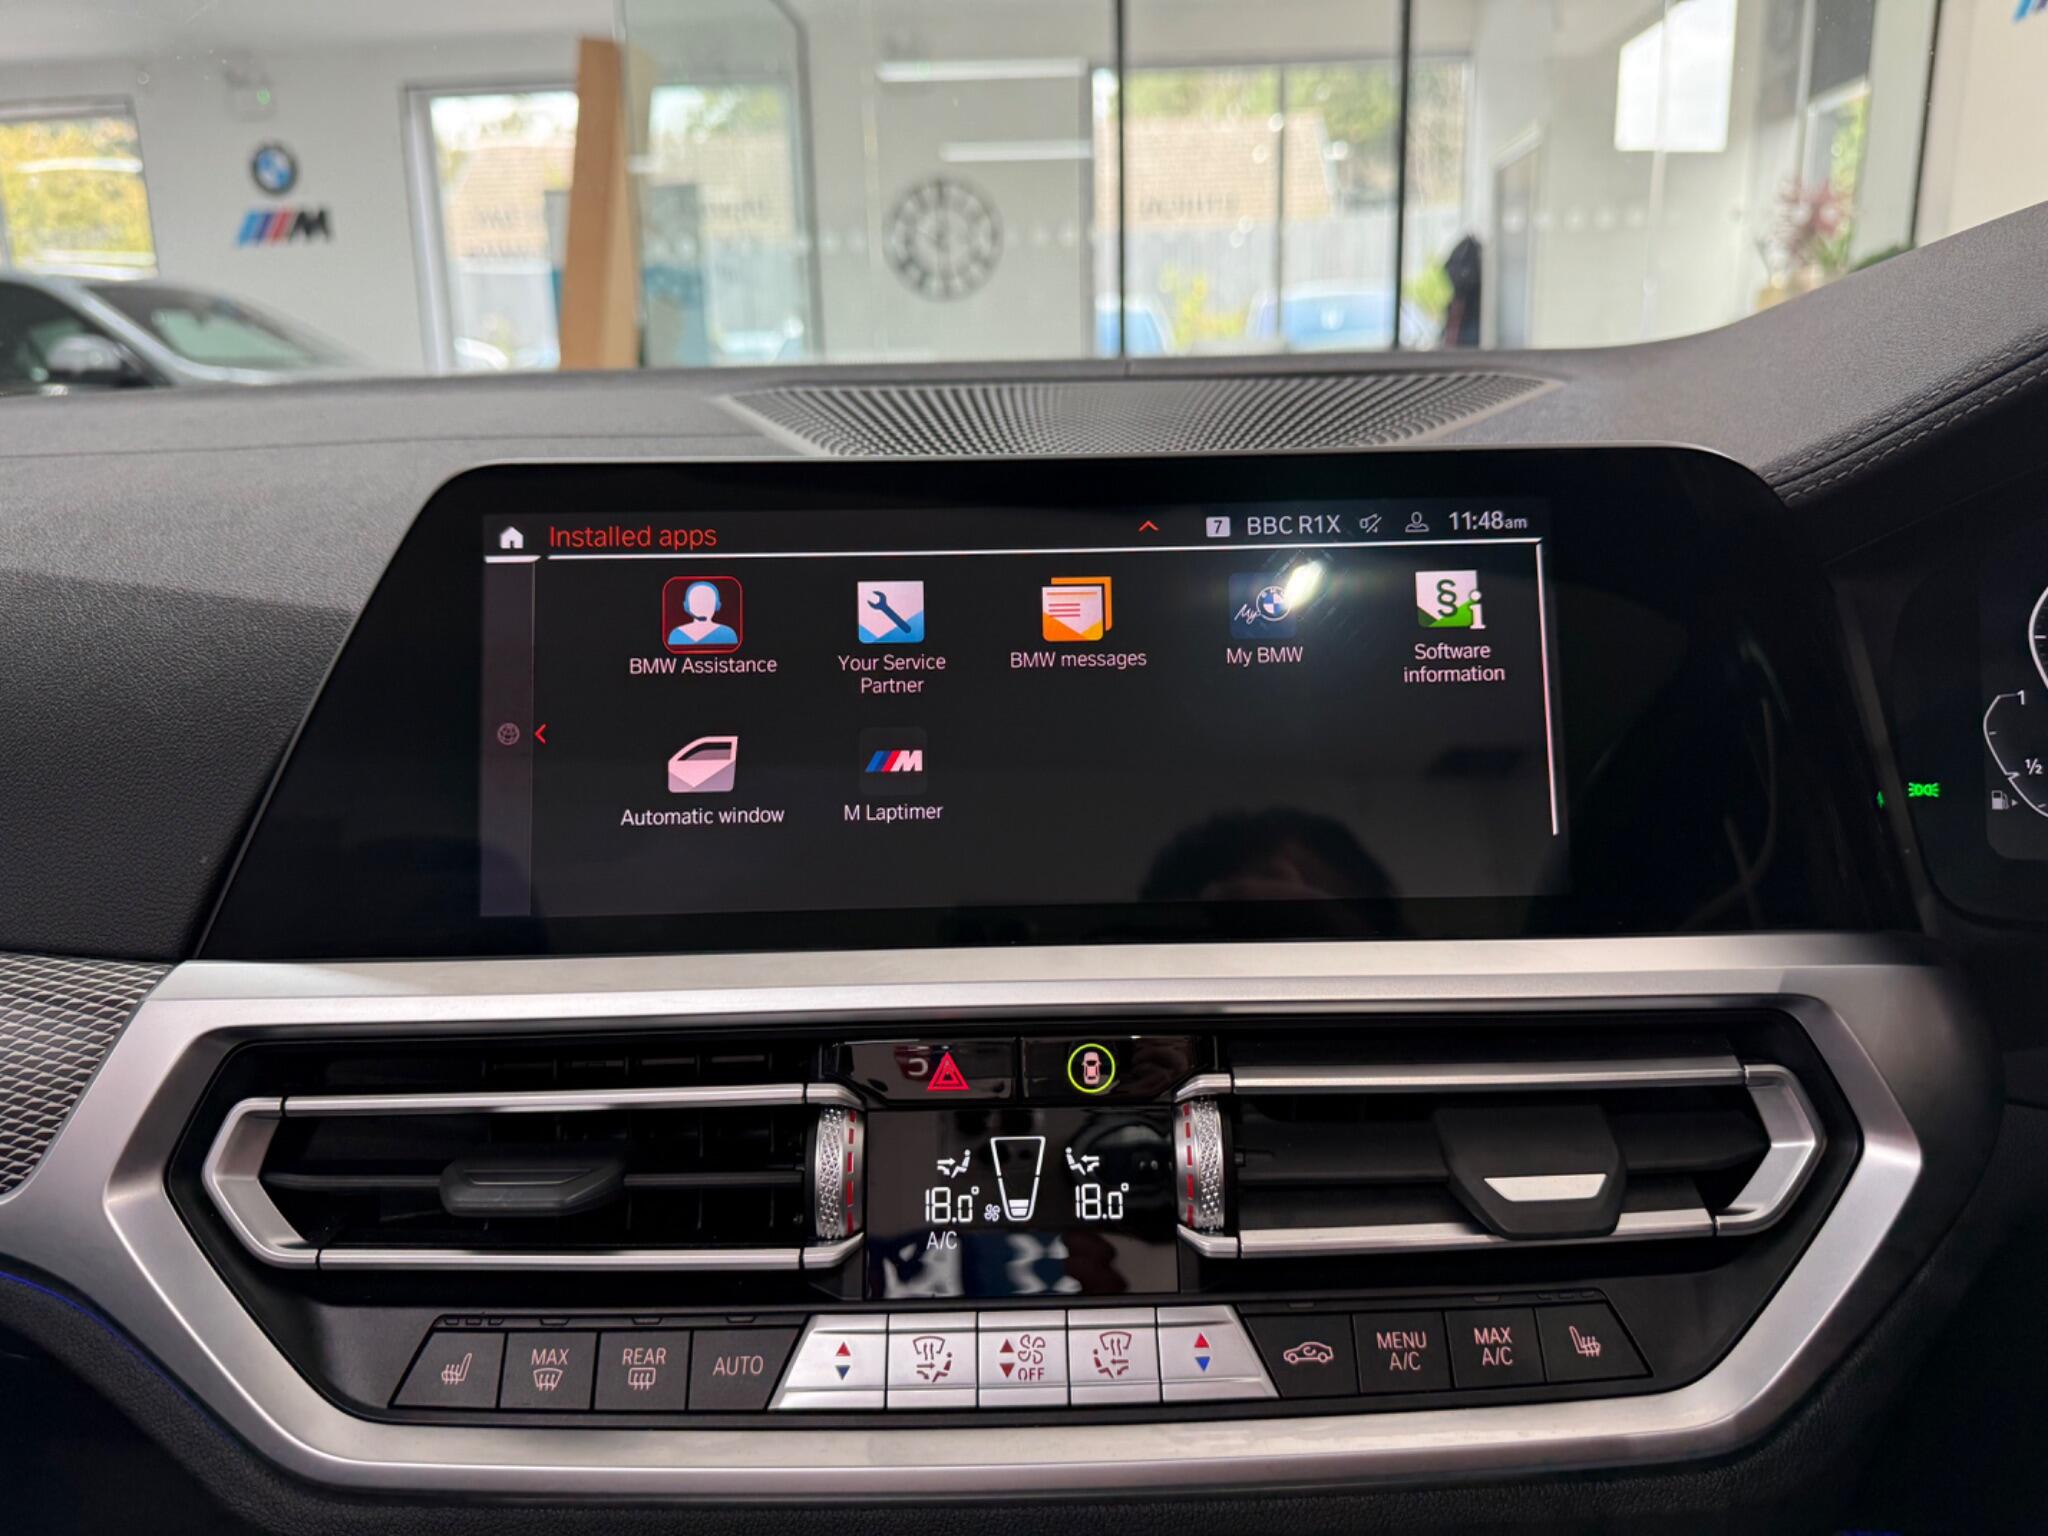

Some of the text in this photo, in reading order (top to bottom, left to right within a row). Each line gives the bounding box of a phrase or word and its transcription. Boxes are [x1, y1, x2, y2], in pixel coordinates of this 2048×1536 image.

[1212, 517, 1224, 536] 7
[1247, 514, 1341, 536] BBC R1X
[1449, 510, 1528, 531] 11:48am
[549, 525, 718, 550] Installed apps
[1010, 651, 1147, 670] BMW messages
[1226, 645, 1304, 668] My BMW
[1414, 642, 1491, 660] Software
[629, 656, 778, 675] BMW Assistance
[838, 653, 946, 672] Your Service
[1403, 665, 1506, 683] information
[861, 677, 924, 694] Partner
[620, 806, 785, 826] Automatic window
[844, 803, 943, 824] M Laptimer
[925, 1230, 959, 1251] A/C
[1376, 1331, 1427, 1349] MENU
[1473, 1327, 1512, 1345] MAX
[531, 1348, 569, 1366] MAX
[622, 1347, 667, 1366] REAR
[1389, 1351, 1421, 1371] A/C
[1482, 1345, 1513, 1366] A/C
[712, 1355, 764, 1376] AUTO
[1017, 1367, 1046, 1381] OFF
